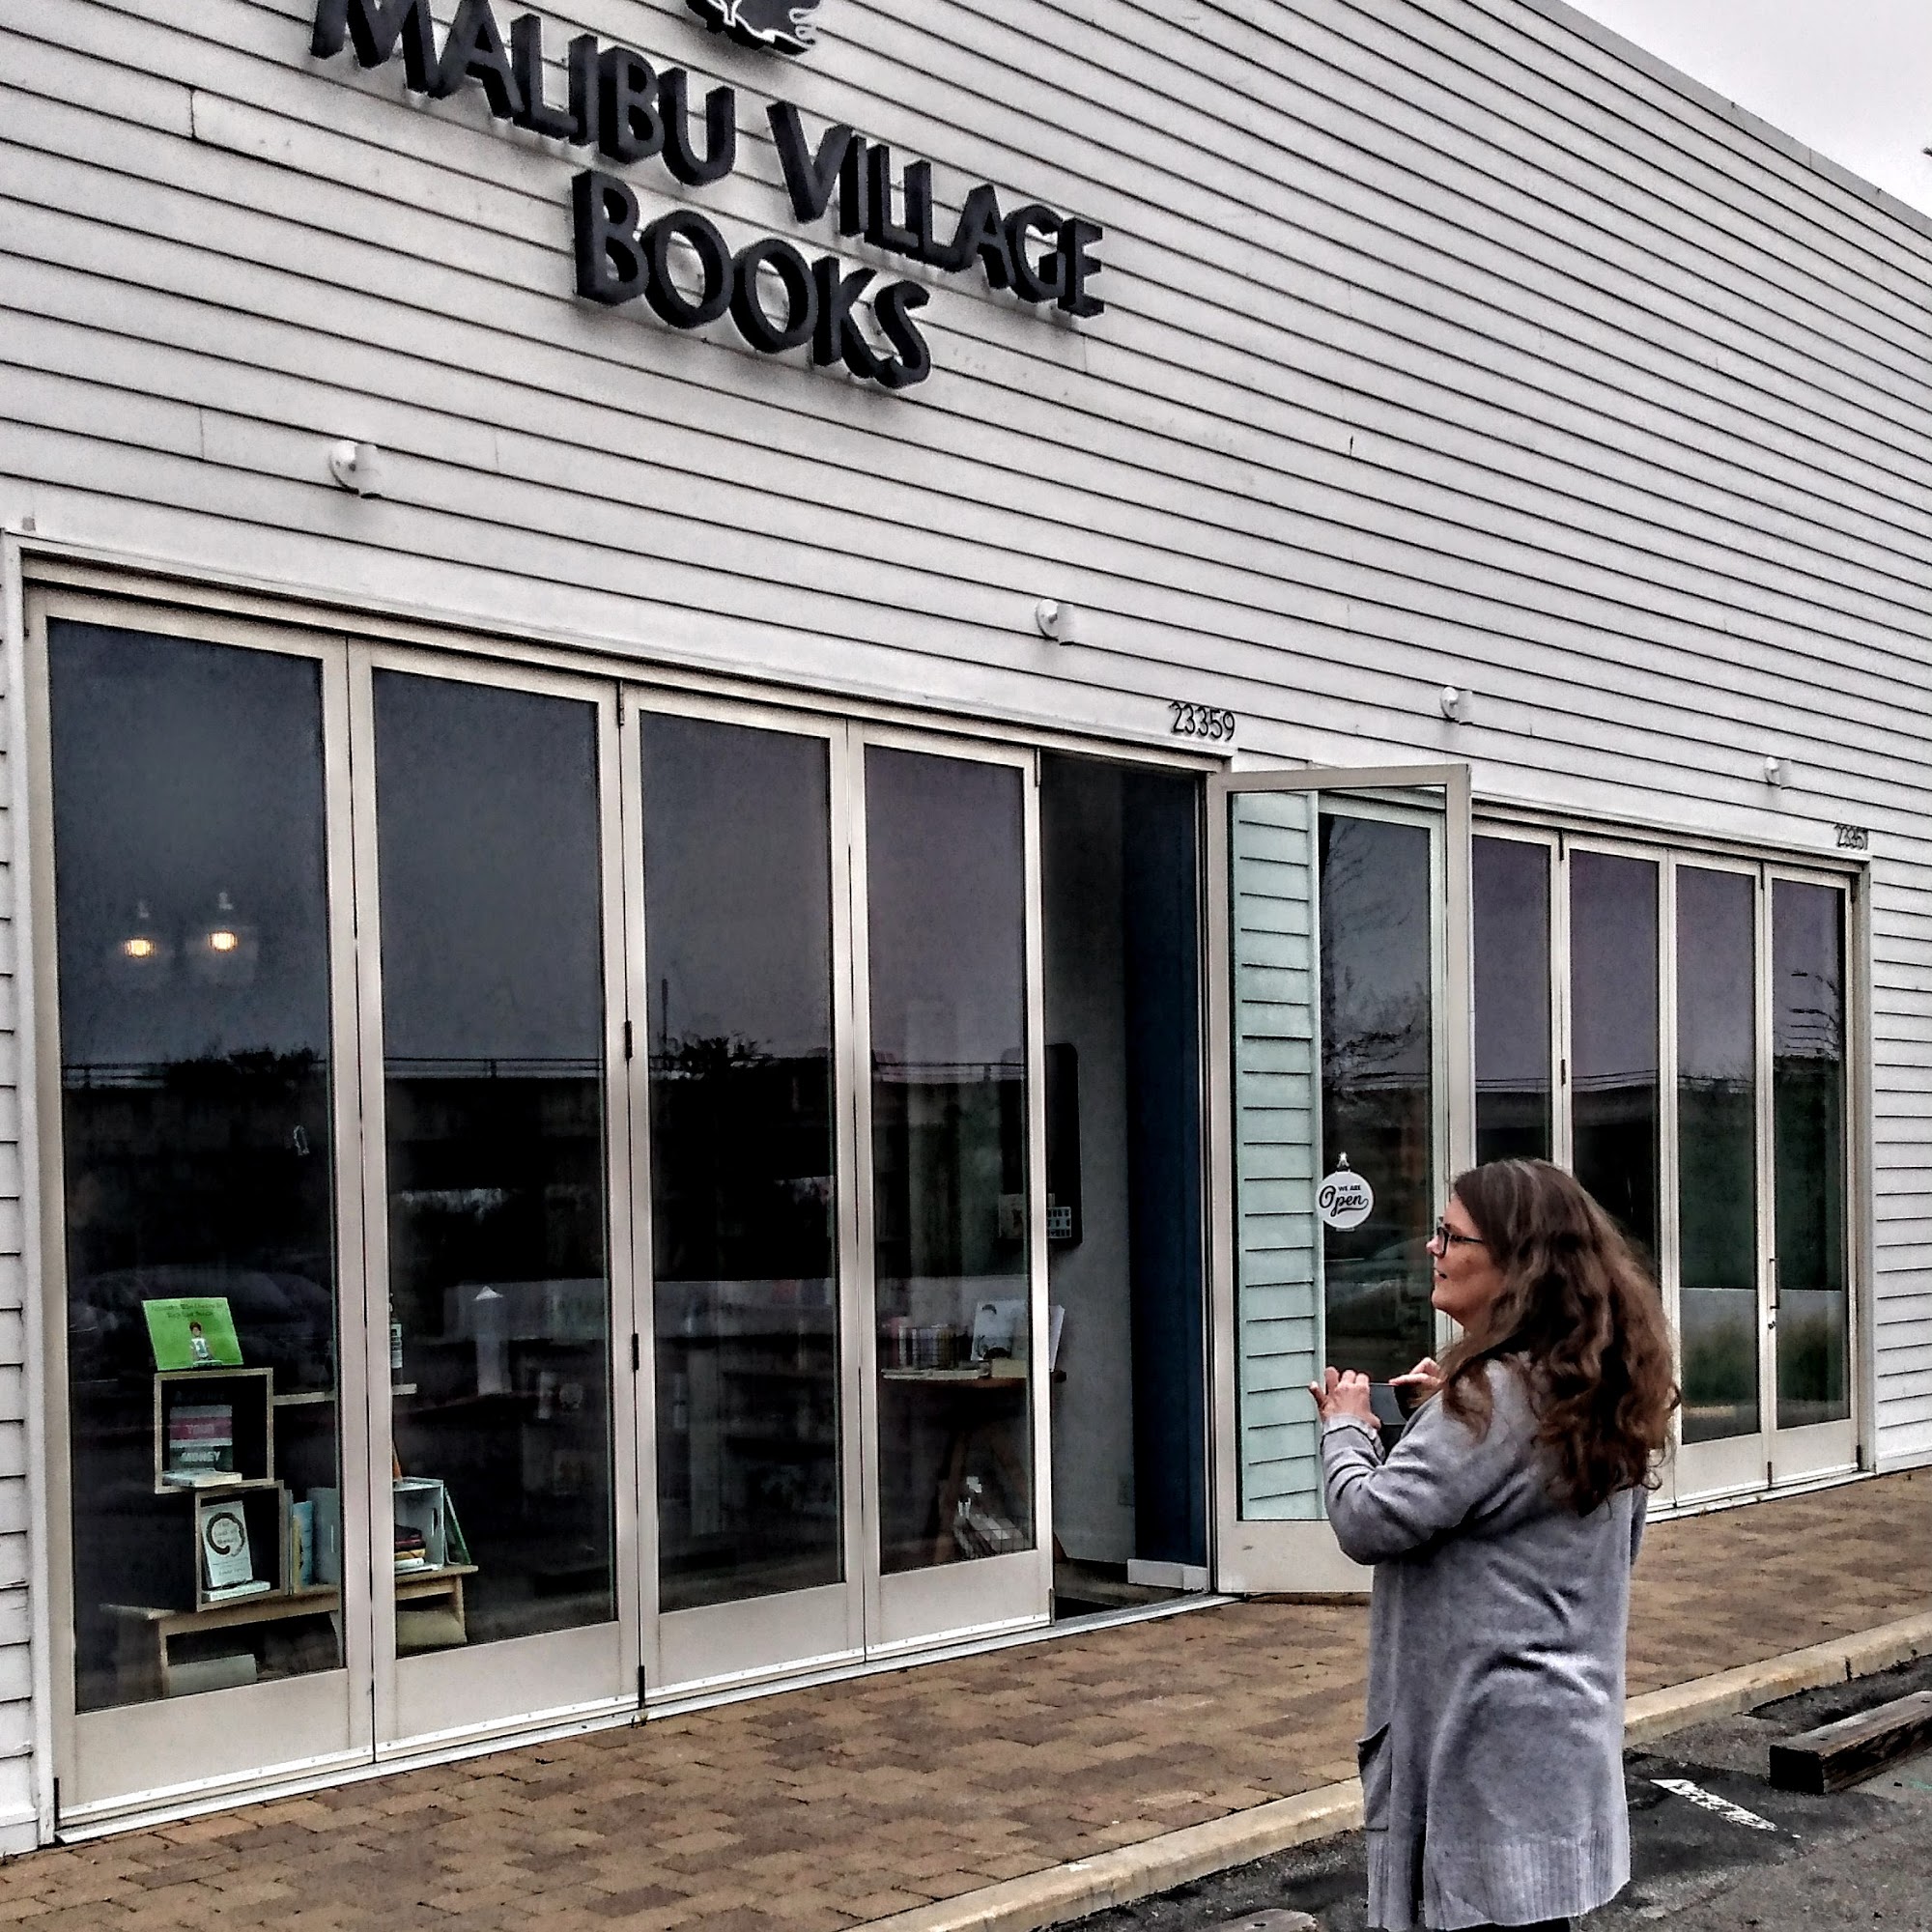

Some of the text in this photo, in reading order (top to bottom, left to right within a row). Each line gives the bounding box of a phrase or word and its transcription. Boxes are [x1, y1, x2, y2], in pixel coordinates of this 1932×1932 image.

[310, 0, 1104, 318] MALIBU VILLAGE
[571, 169, 931, 389] BOOKS
[1168, 700, 1236, 742] 23359
[1319, 1184, 1370, 1217] Open
